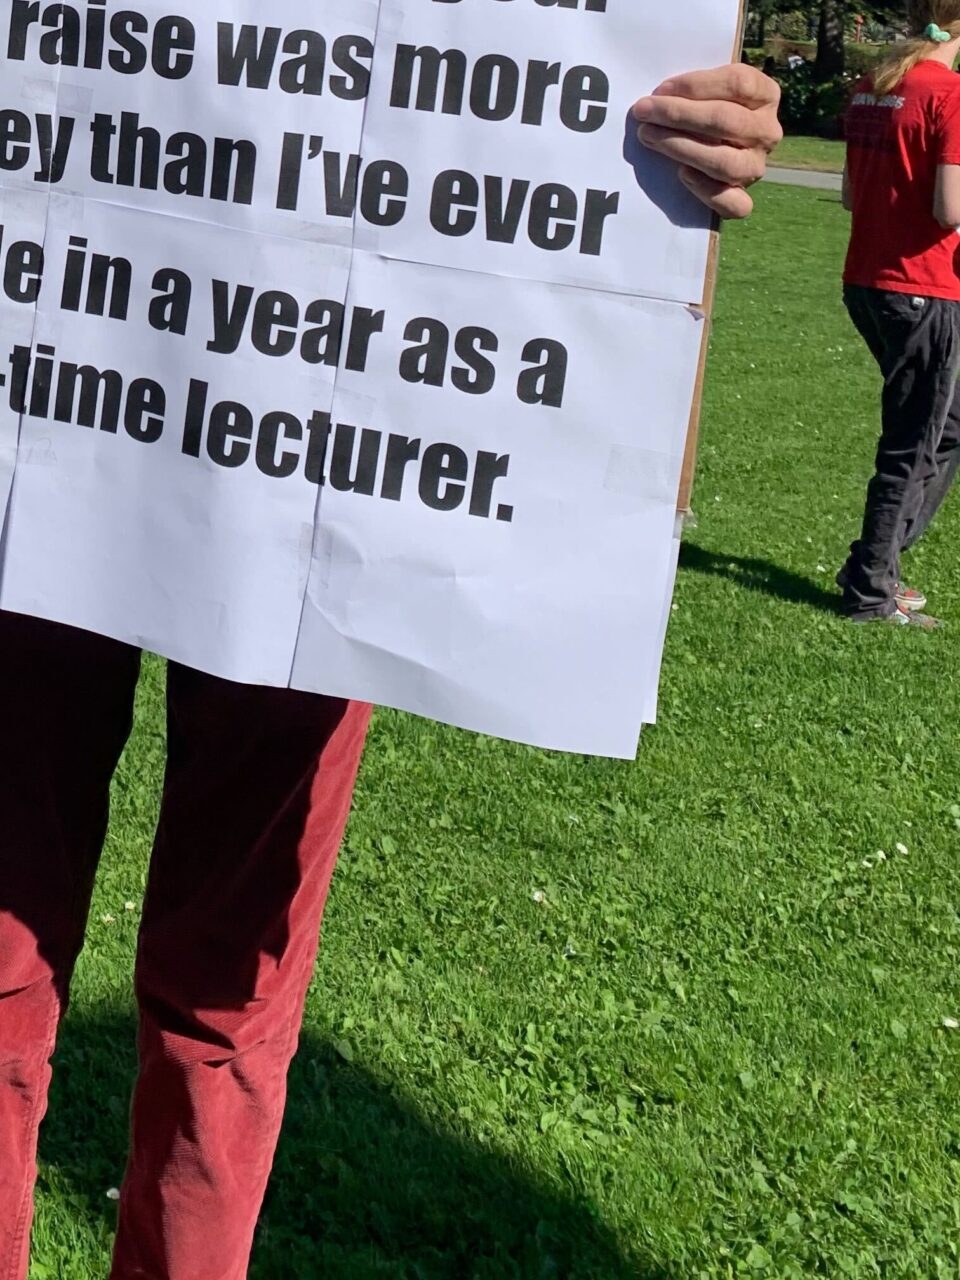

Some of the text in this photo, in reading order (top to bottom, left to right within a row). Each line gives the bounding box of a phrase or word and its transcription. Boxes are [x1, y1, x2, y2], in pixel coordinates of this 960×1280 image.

[217, 22, 375, 102] was
[389, 43, 609, 133] more
[89, 111, 257, 205] than
[429, 169, 620, 256] ever
[60, 235, 133, 321] in
[147, 267, 192, 336] a
[206, 278, 385, 373] year
[398, 316, 499, 395] as
[516, 337, 568, 409] a
[181, 377, 514, 522] lecturer.
